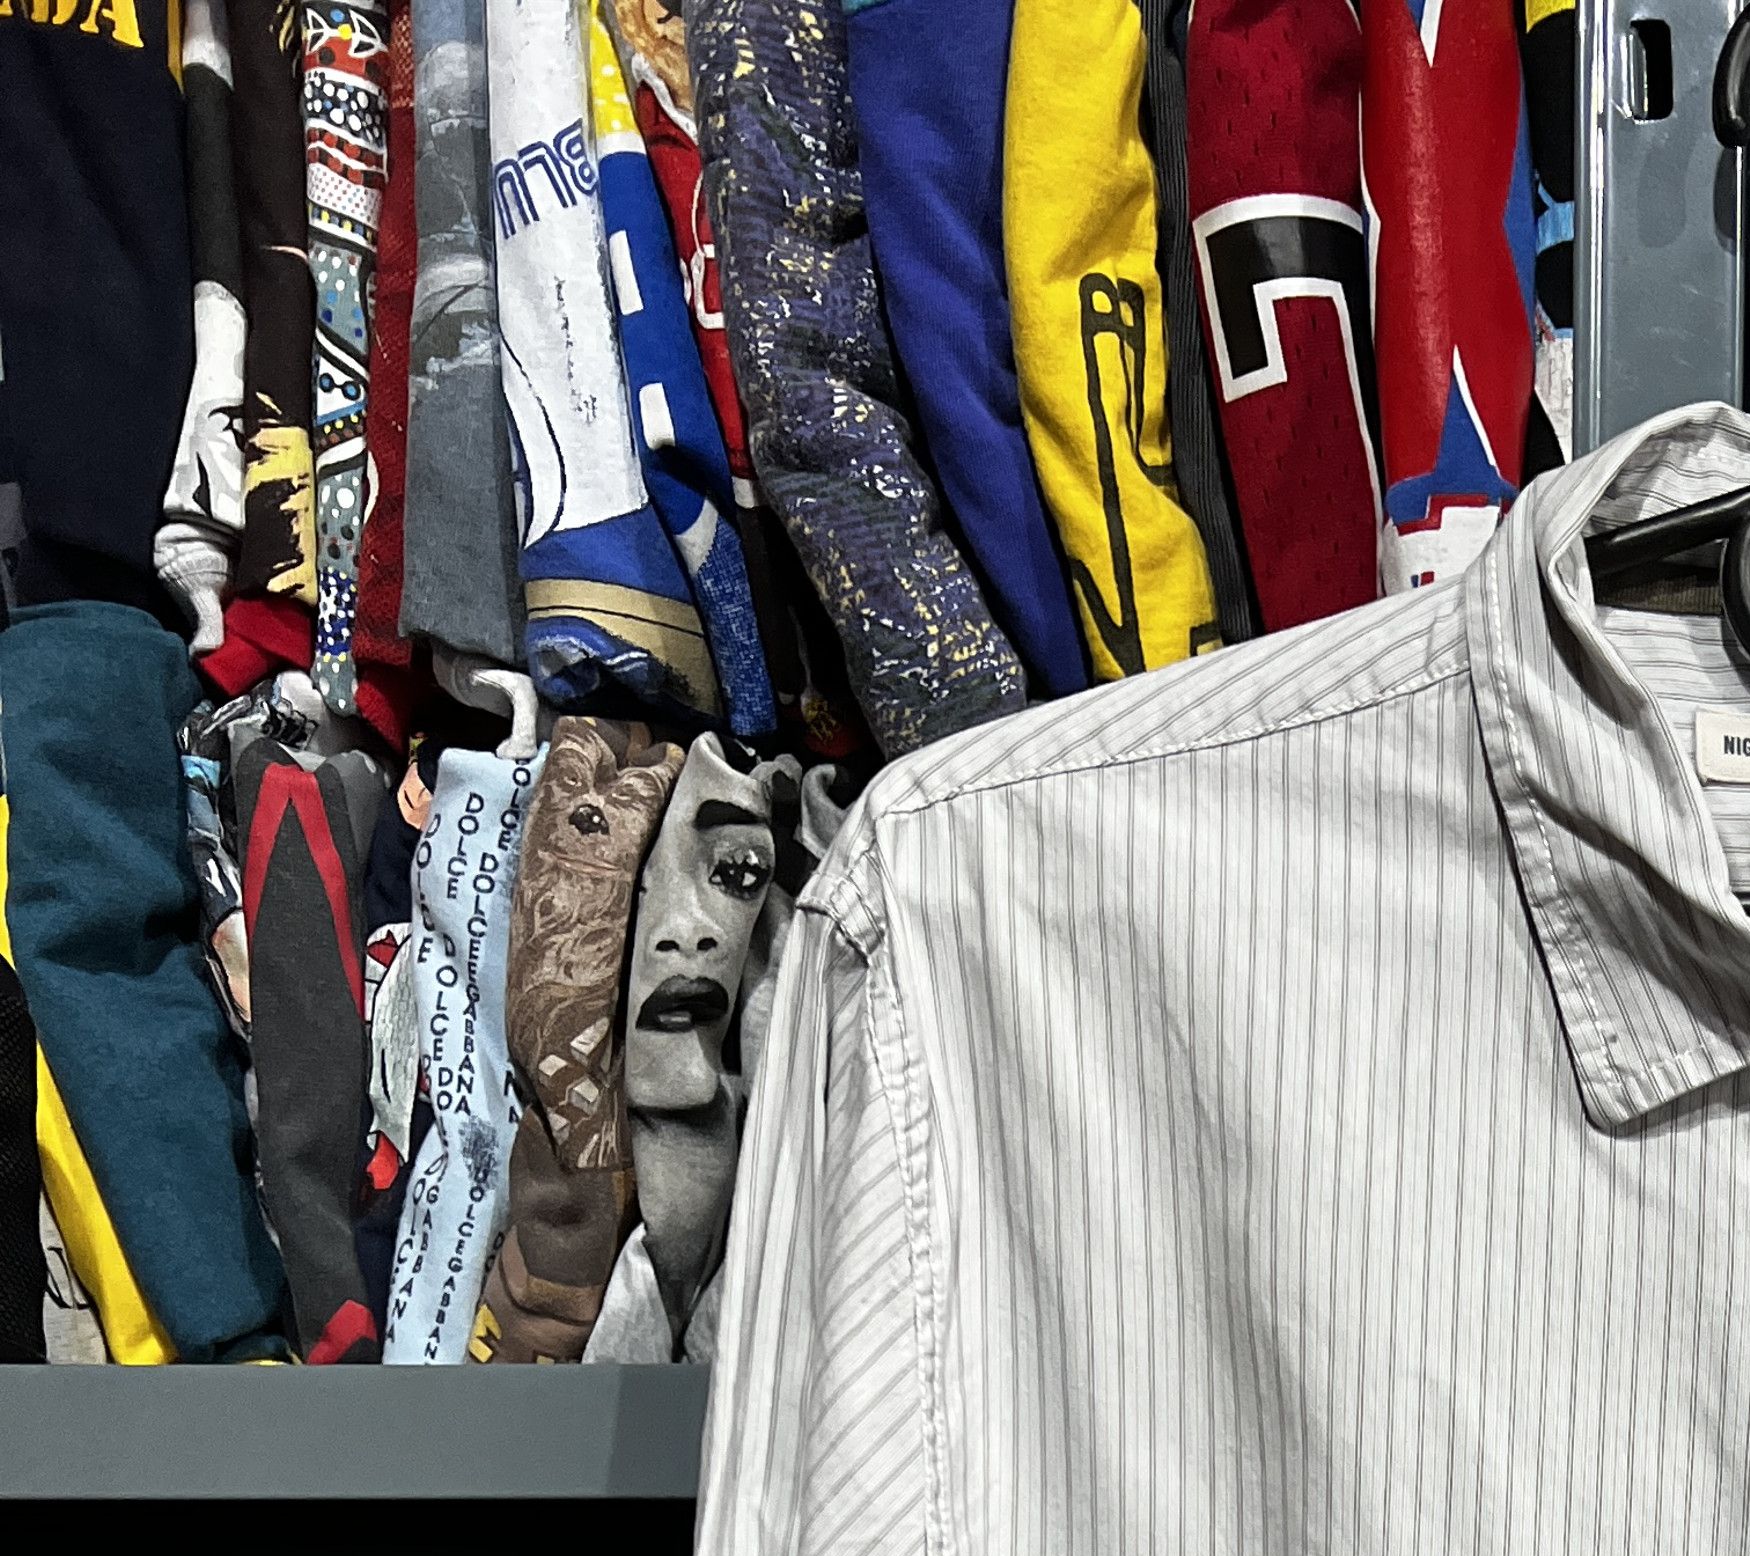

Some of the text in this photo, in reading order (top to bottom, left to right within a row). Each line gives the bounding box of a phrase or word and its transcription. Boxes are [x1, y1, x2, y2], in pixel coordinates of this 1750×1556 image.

[494, 117, 598, 239] BLU
[446, 792, 485, 900] DOLCE
[497, 758, 531, 851] OLCE
